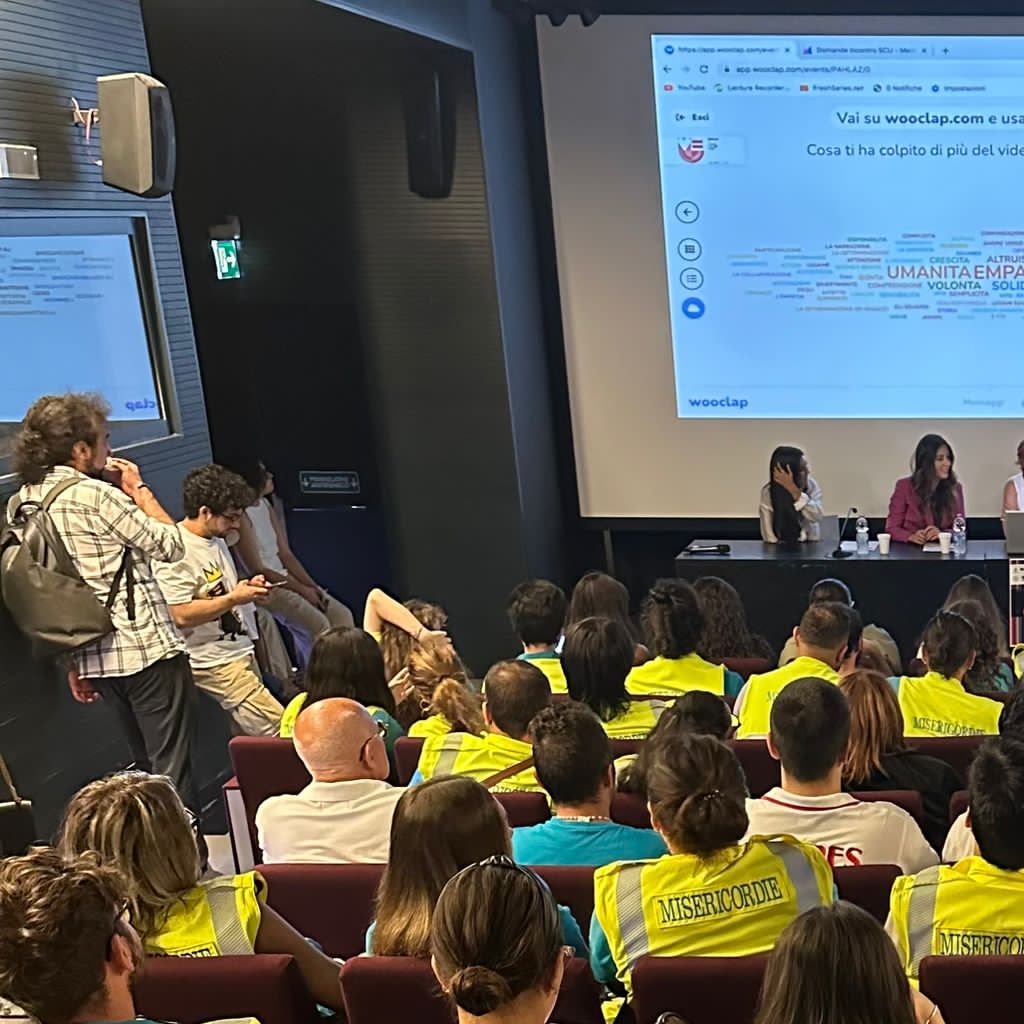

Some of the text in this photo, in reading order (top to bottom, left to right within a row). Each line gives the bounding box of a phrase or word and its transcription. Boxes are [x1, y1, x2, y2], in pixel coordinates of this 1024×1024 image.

[692, 113, 709, 121] Esci
[836, 111, 860, 124] Vai
[864, 114, 881, 124] su
[885, 112, 984, 127] wooclap.com
[988, 114, 997, 124] e
[807, 143, 842, 156] Cosa
[845, 144, 855, 156] ti
[858, 143, 875, 156] ha
[879, 143, 926, 159] colpito
[930, 143, 943, 156] di
[947, 142, 968, 158] più
[972, 143, 994, 156] del
[929, 256, 970, 264] CRESCITA
[887, 265, 969, 279] UMANITA
[928, 281, 982, 290] VOLONTA
[688, 395, 749, 409] wooclap
[657, 876, 783, 924] MISERICORDIE
